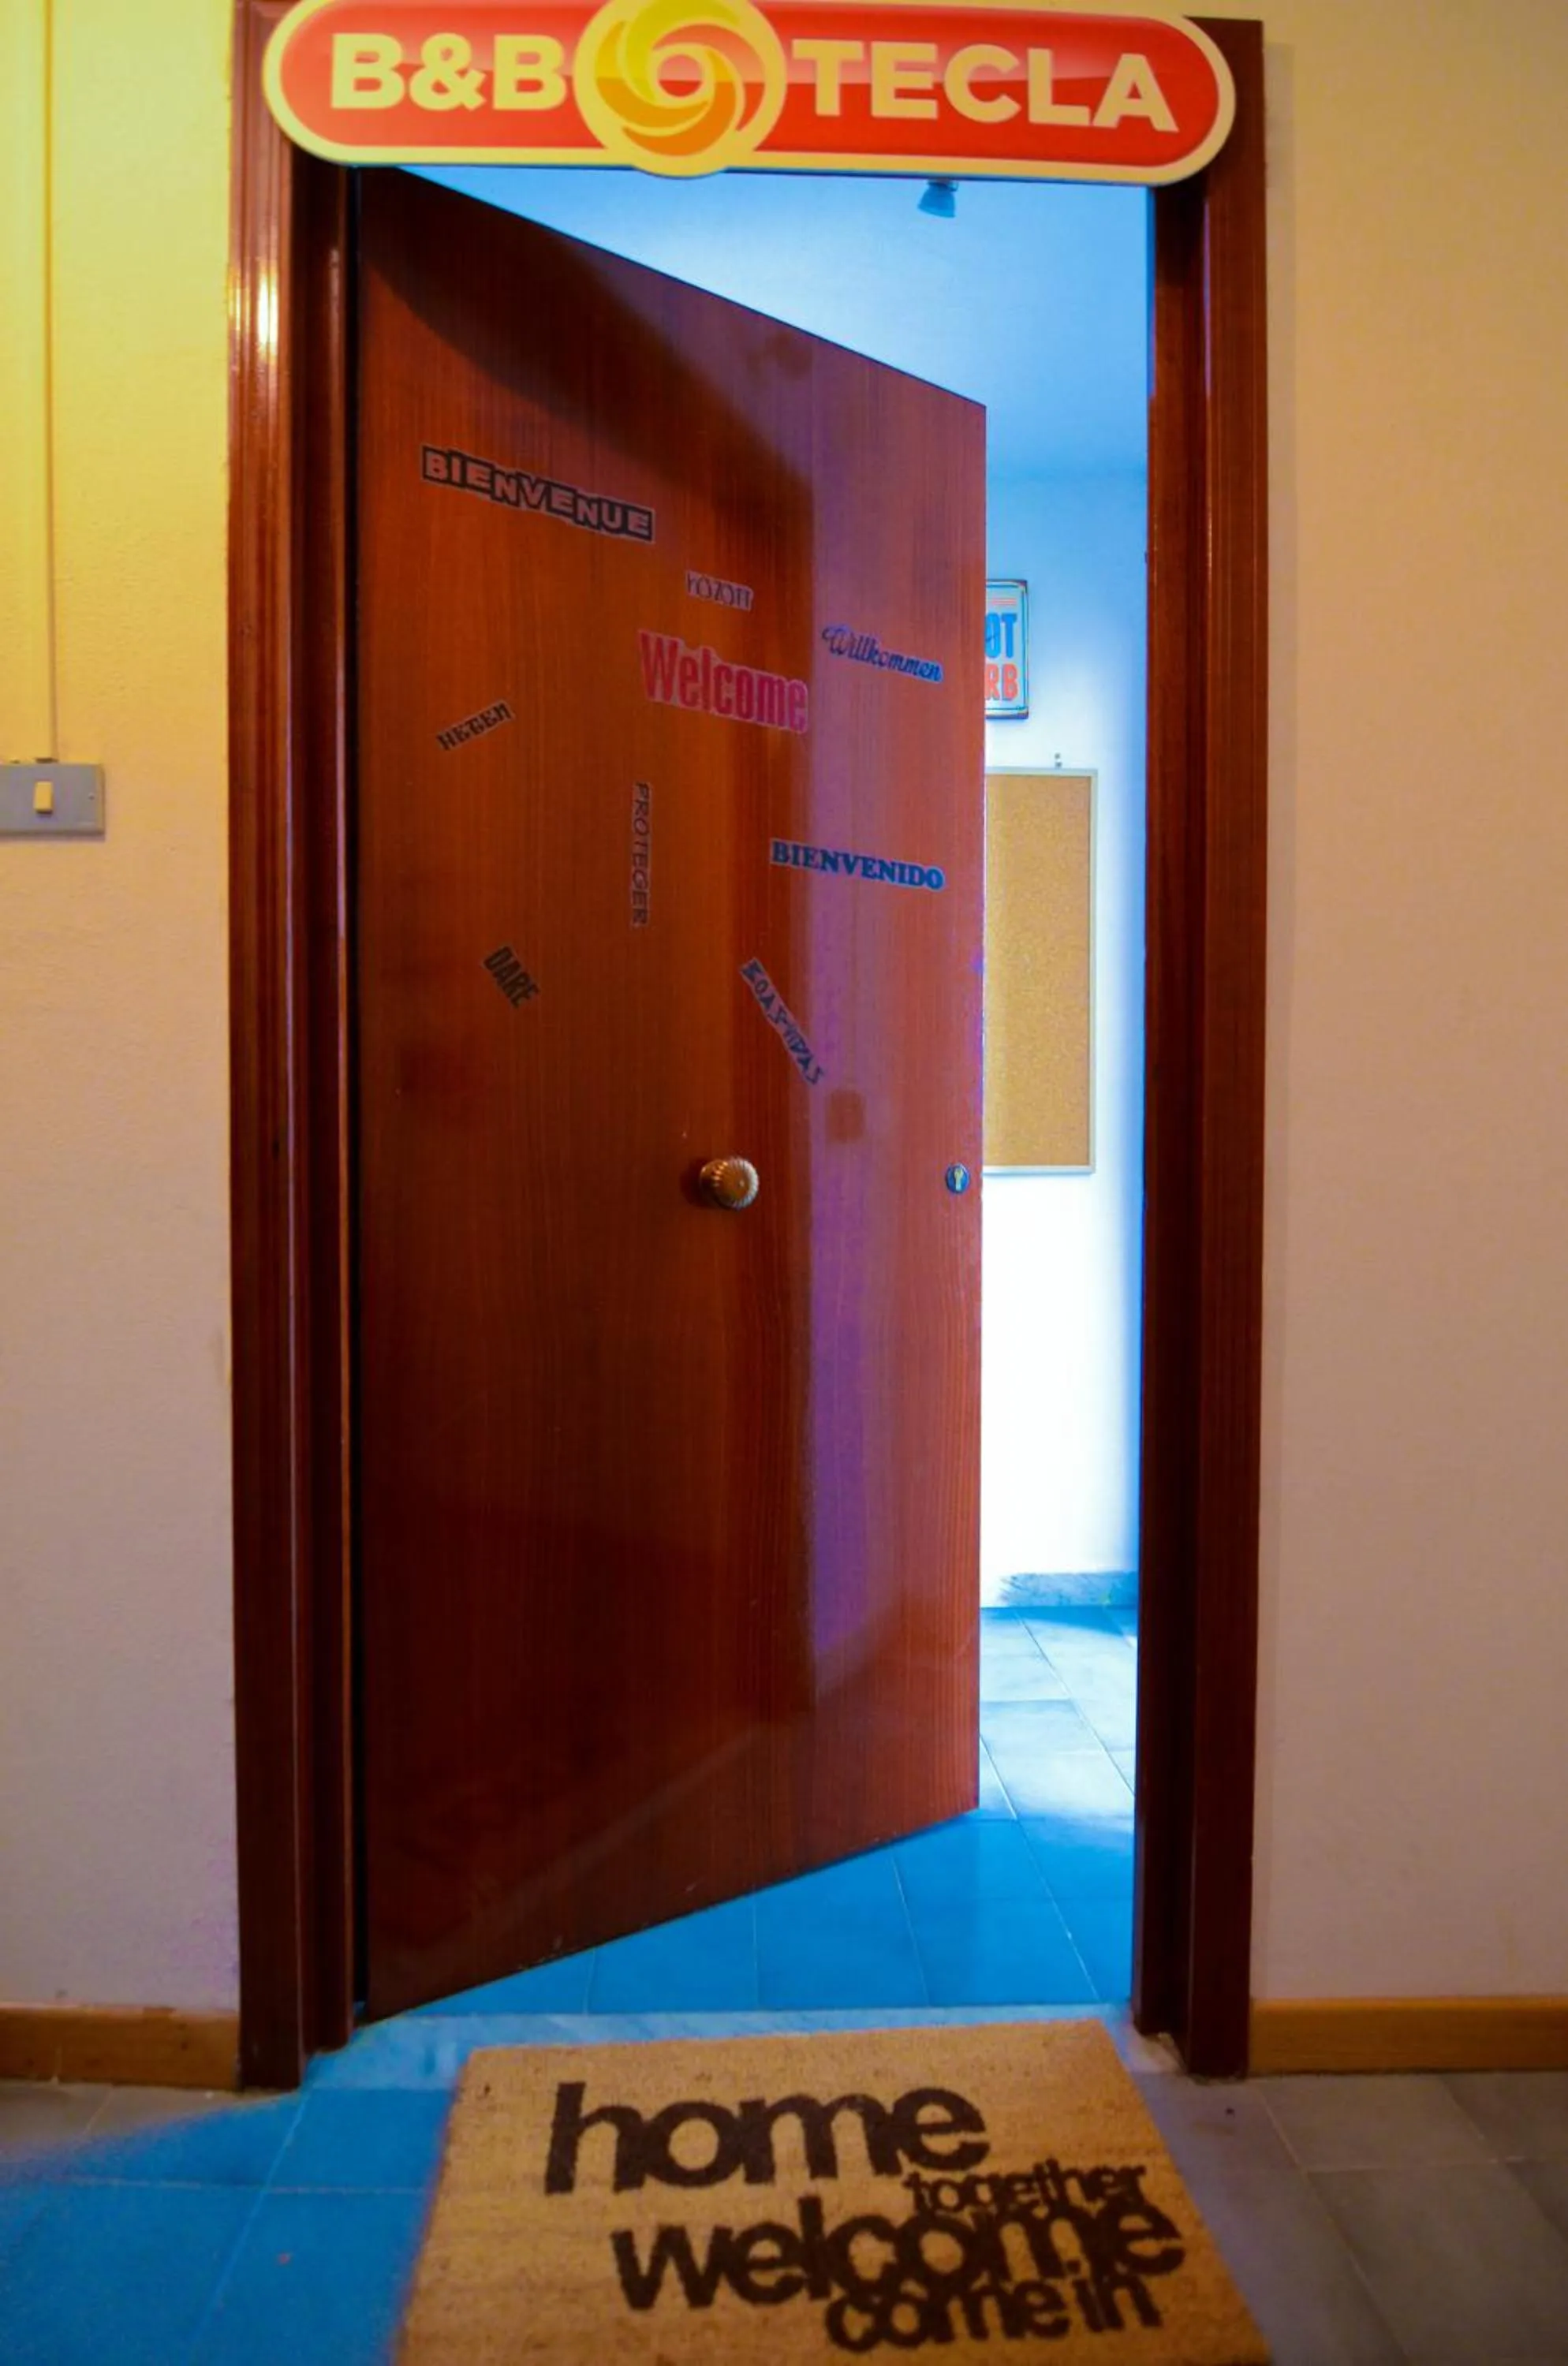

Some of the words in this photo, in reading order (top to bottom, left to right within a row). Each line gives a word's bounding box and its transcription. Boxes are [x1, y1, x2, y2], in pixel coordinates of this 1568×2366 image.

[331, 32, 566, 111] B&B
[793, 39, 1179, 133] TECLA
[423, 447, 653, 541] BIENVENUE
[640, 632, 808, 732] Welcome
[821, 629, 941, 683] Willkommen
[984, 613, 1017, 659] OT
[633, 782, 650, 926] PROTEGER
[772, 841, 944, 890] BIENVENIDO
[483, 946, 540, 1009] DARE
[544, 2081, 991, 2194] home
[903, 2159, 1146, 2215] together
[610, 2196, 1186, 2311] welcome
[825, 2278, 1070, 2352] come
[1066, 2260, 1163, 2333] in
